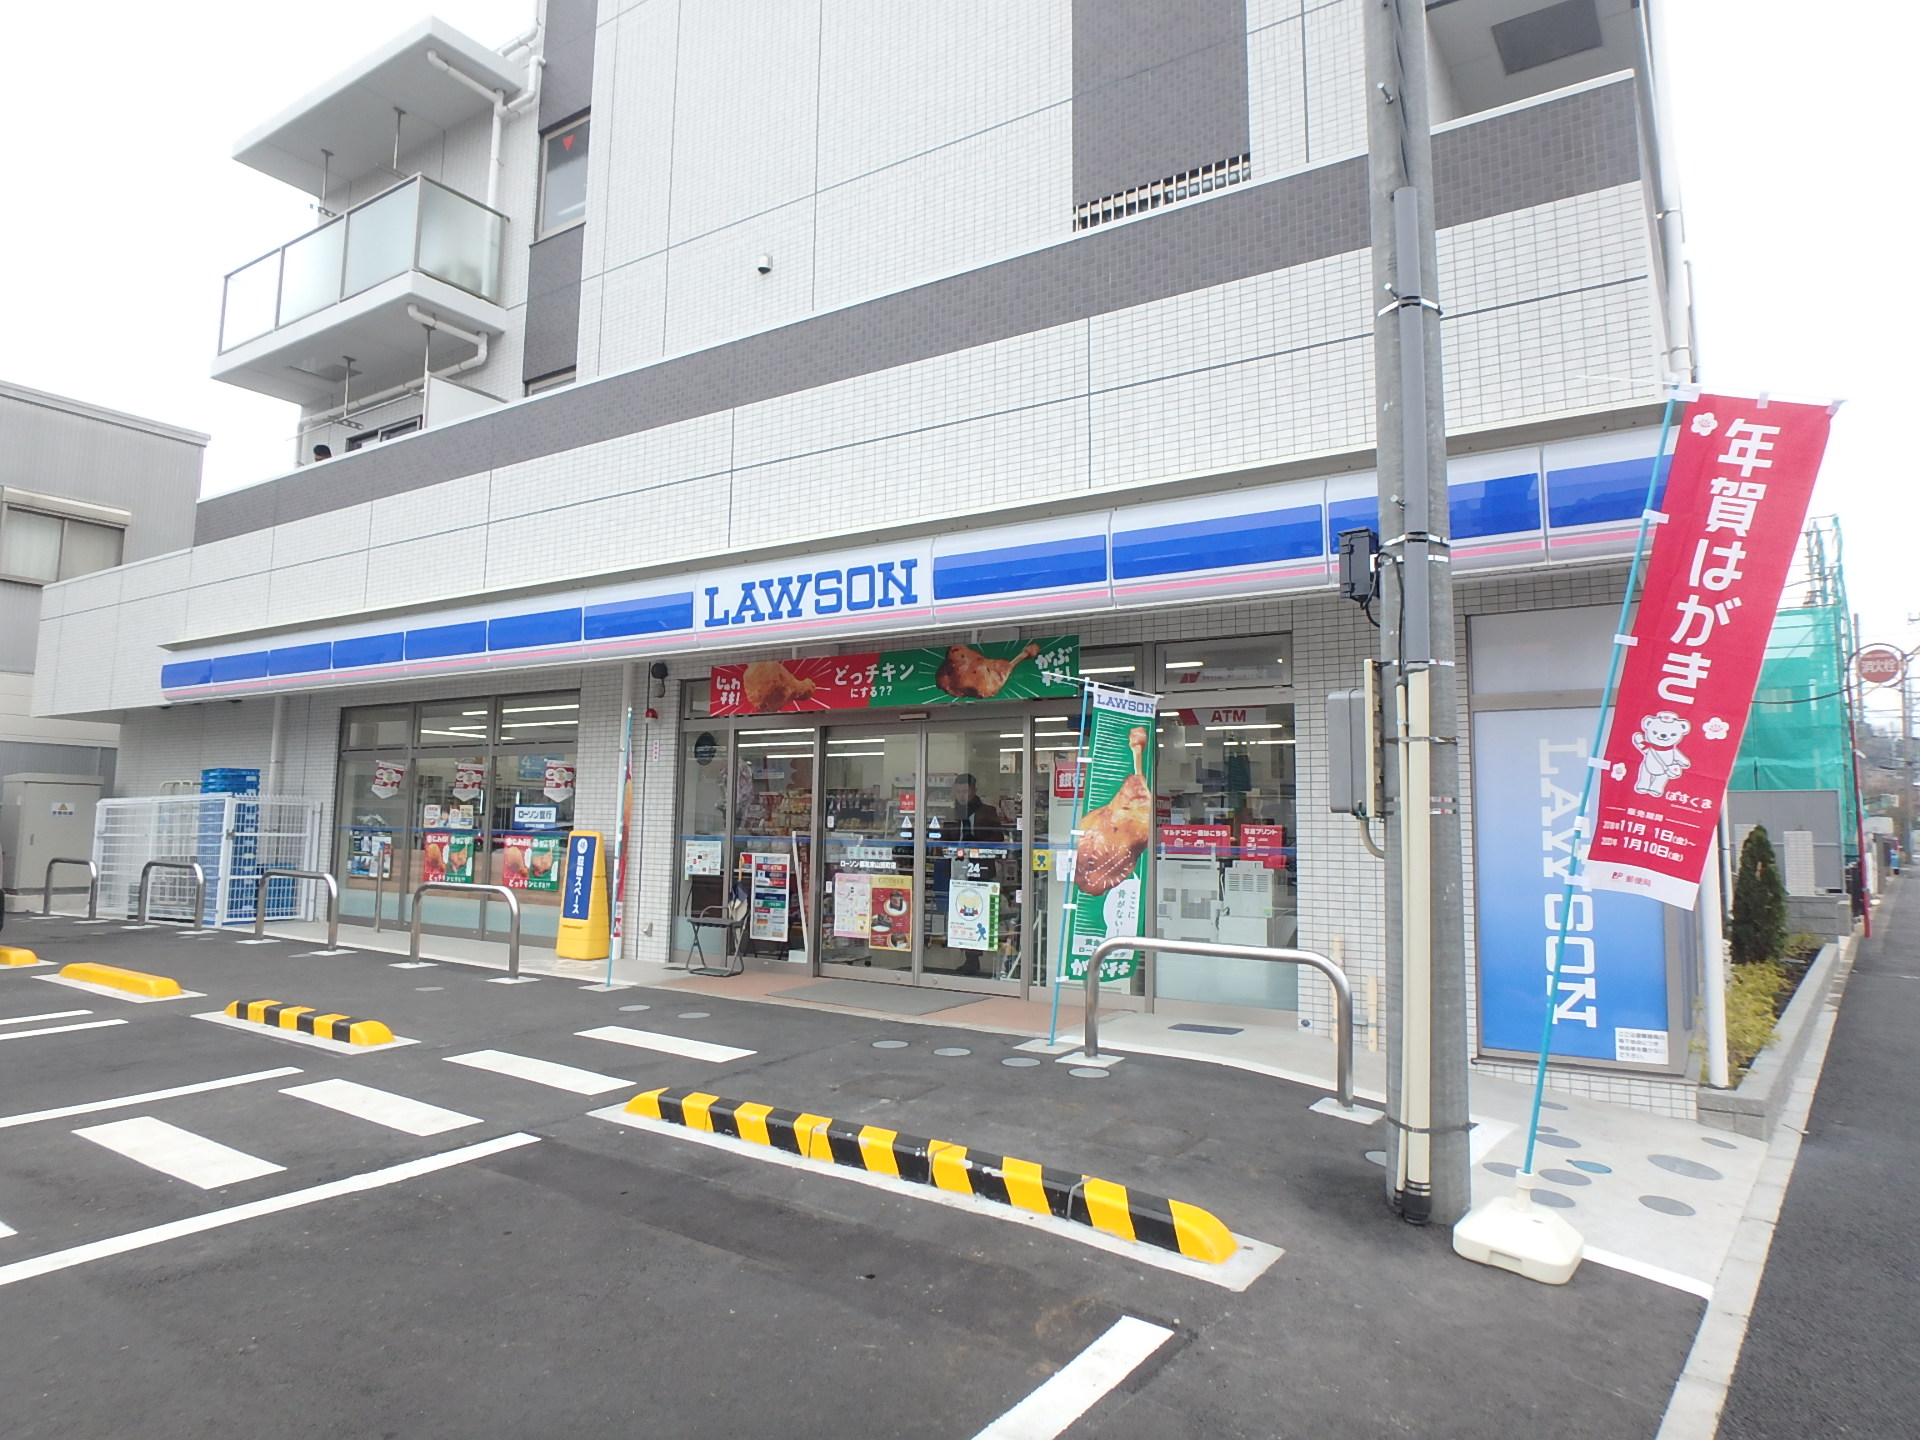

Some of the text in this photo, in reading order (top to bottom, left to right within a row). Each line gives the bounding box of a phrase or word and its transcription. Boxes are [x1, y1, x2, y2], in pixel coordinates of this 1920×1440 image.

[1657, 418, 1781, 705] 年賀はがき
[704, 558, 918, 627] LAWSON
[834, 661, 915, 686] どっチキン
[1861, 659, 1896, 673] 消火栓
[1096, 693, 1155, 715] LAWSON
[1210, 709, 1247, 723] ATM
[1665, 790, 1713, 809] ぽすくま
[518, 810, 553, 820] ローソン銀行
[1243, 828, 1278, 836] 写真プリント
[1538, 737, 1597, 1029] LAWSON
